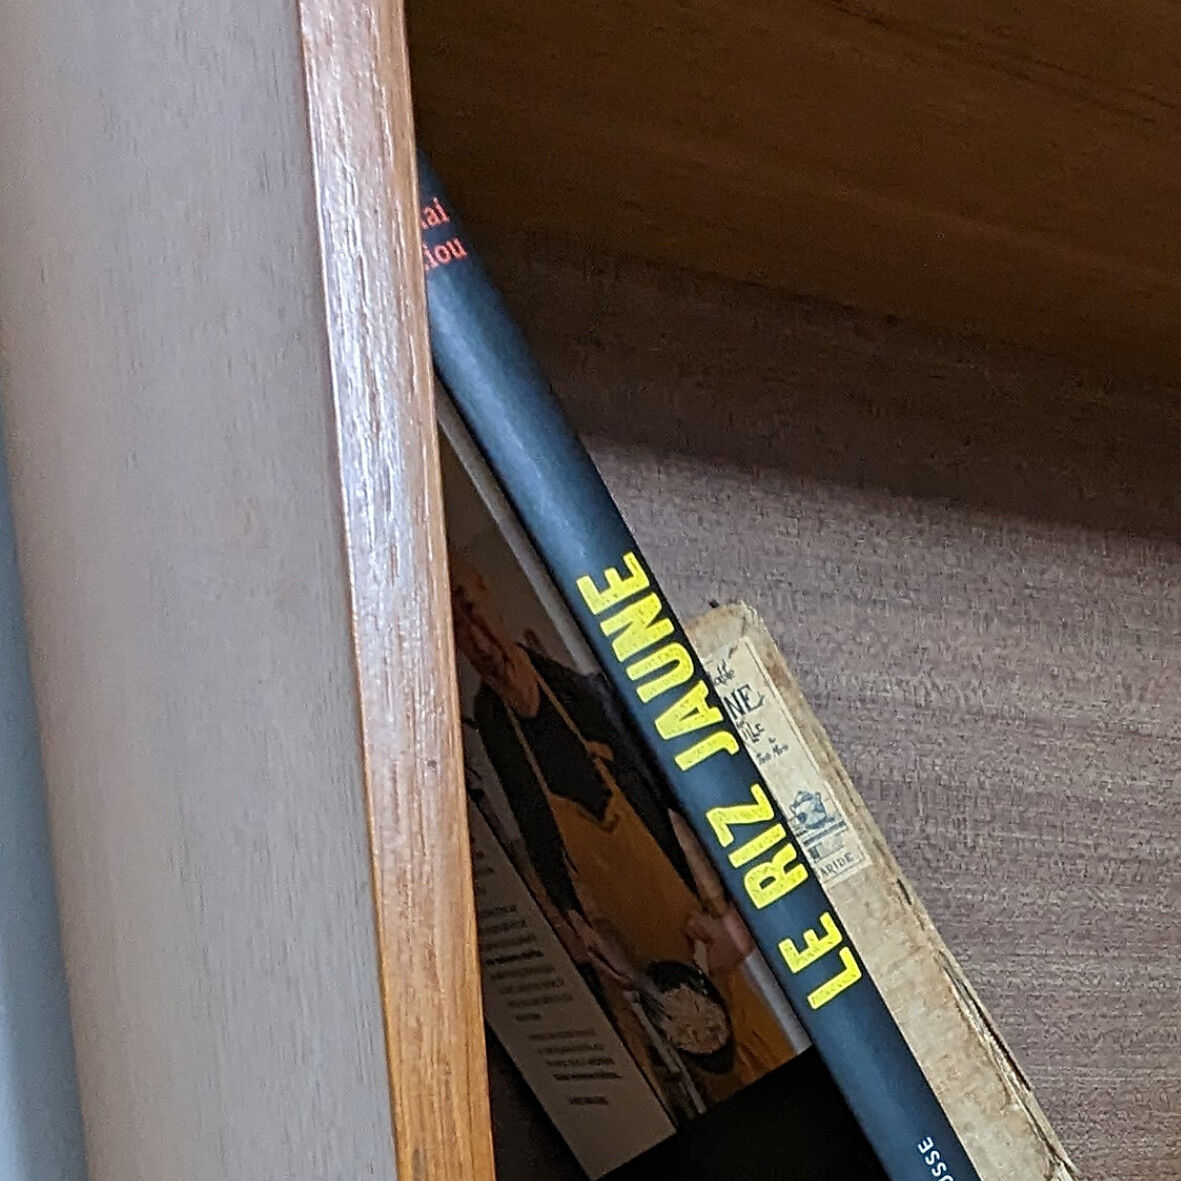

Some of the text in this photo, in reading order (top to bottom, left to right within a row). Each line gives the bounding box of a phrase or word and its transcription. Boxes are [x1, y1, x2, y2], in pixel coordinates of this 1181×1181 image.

[420, 196, 451, 230] ai
[422, 237, 468, 271] iou
[576, 551, 863, 1010] LE RIZ JAUNE
